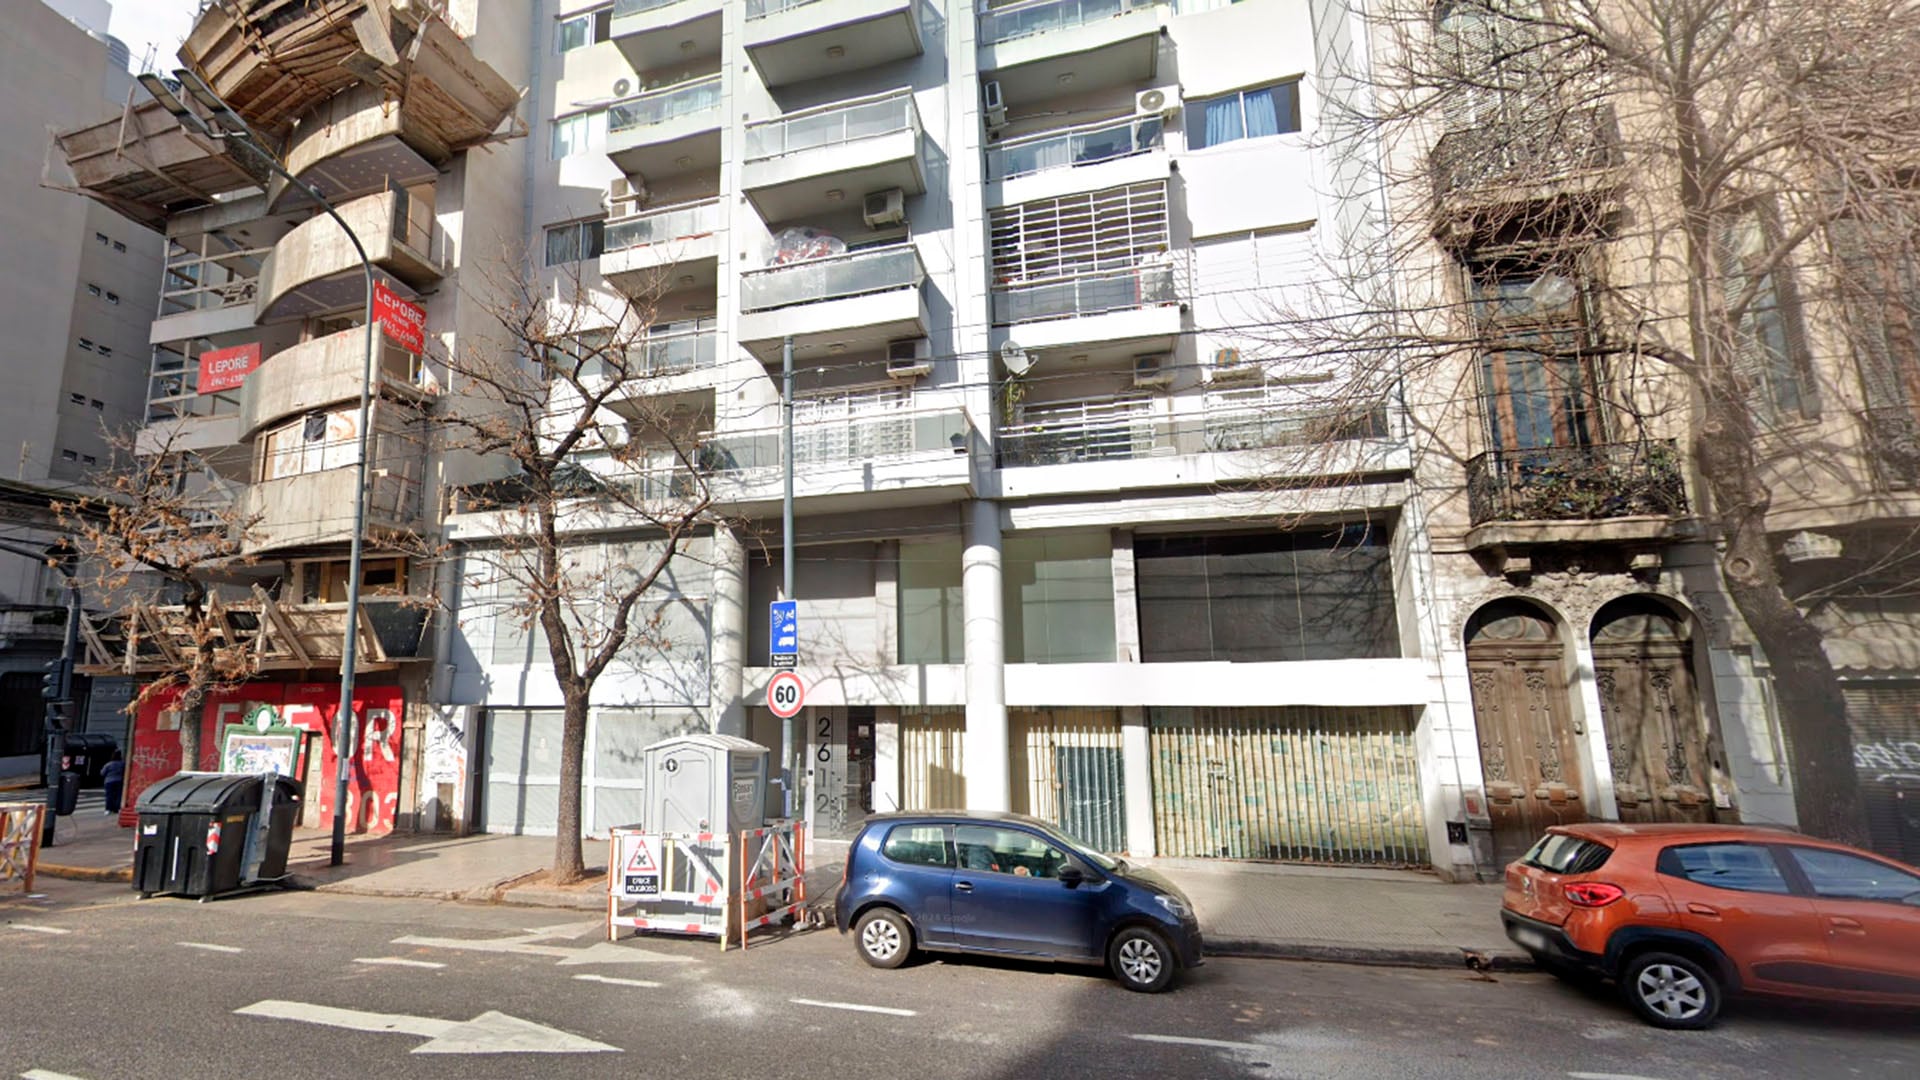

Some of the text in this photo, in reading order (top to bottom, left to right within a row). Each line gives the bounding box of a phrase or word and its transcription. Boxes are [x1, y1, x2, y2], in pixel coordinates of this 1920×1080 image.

[376, 287, 423, 325] LEPORE
[208, 355, 249, 376] LEPORE
[775, 685, 796, 703] 60
[817, 716, 831, 814] 2612
